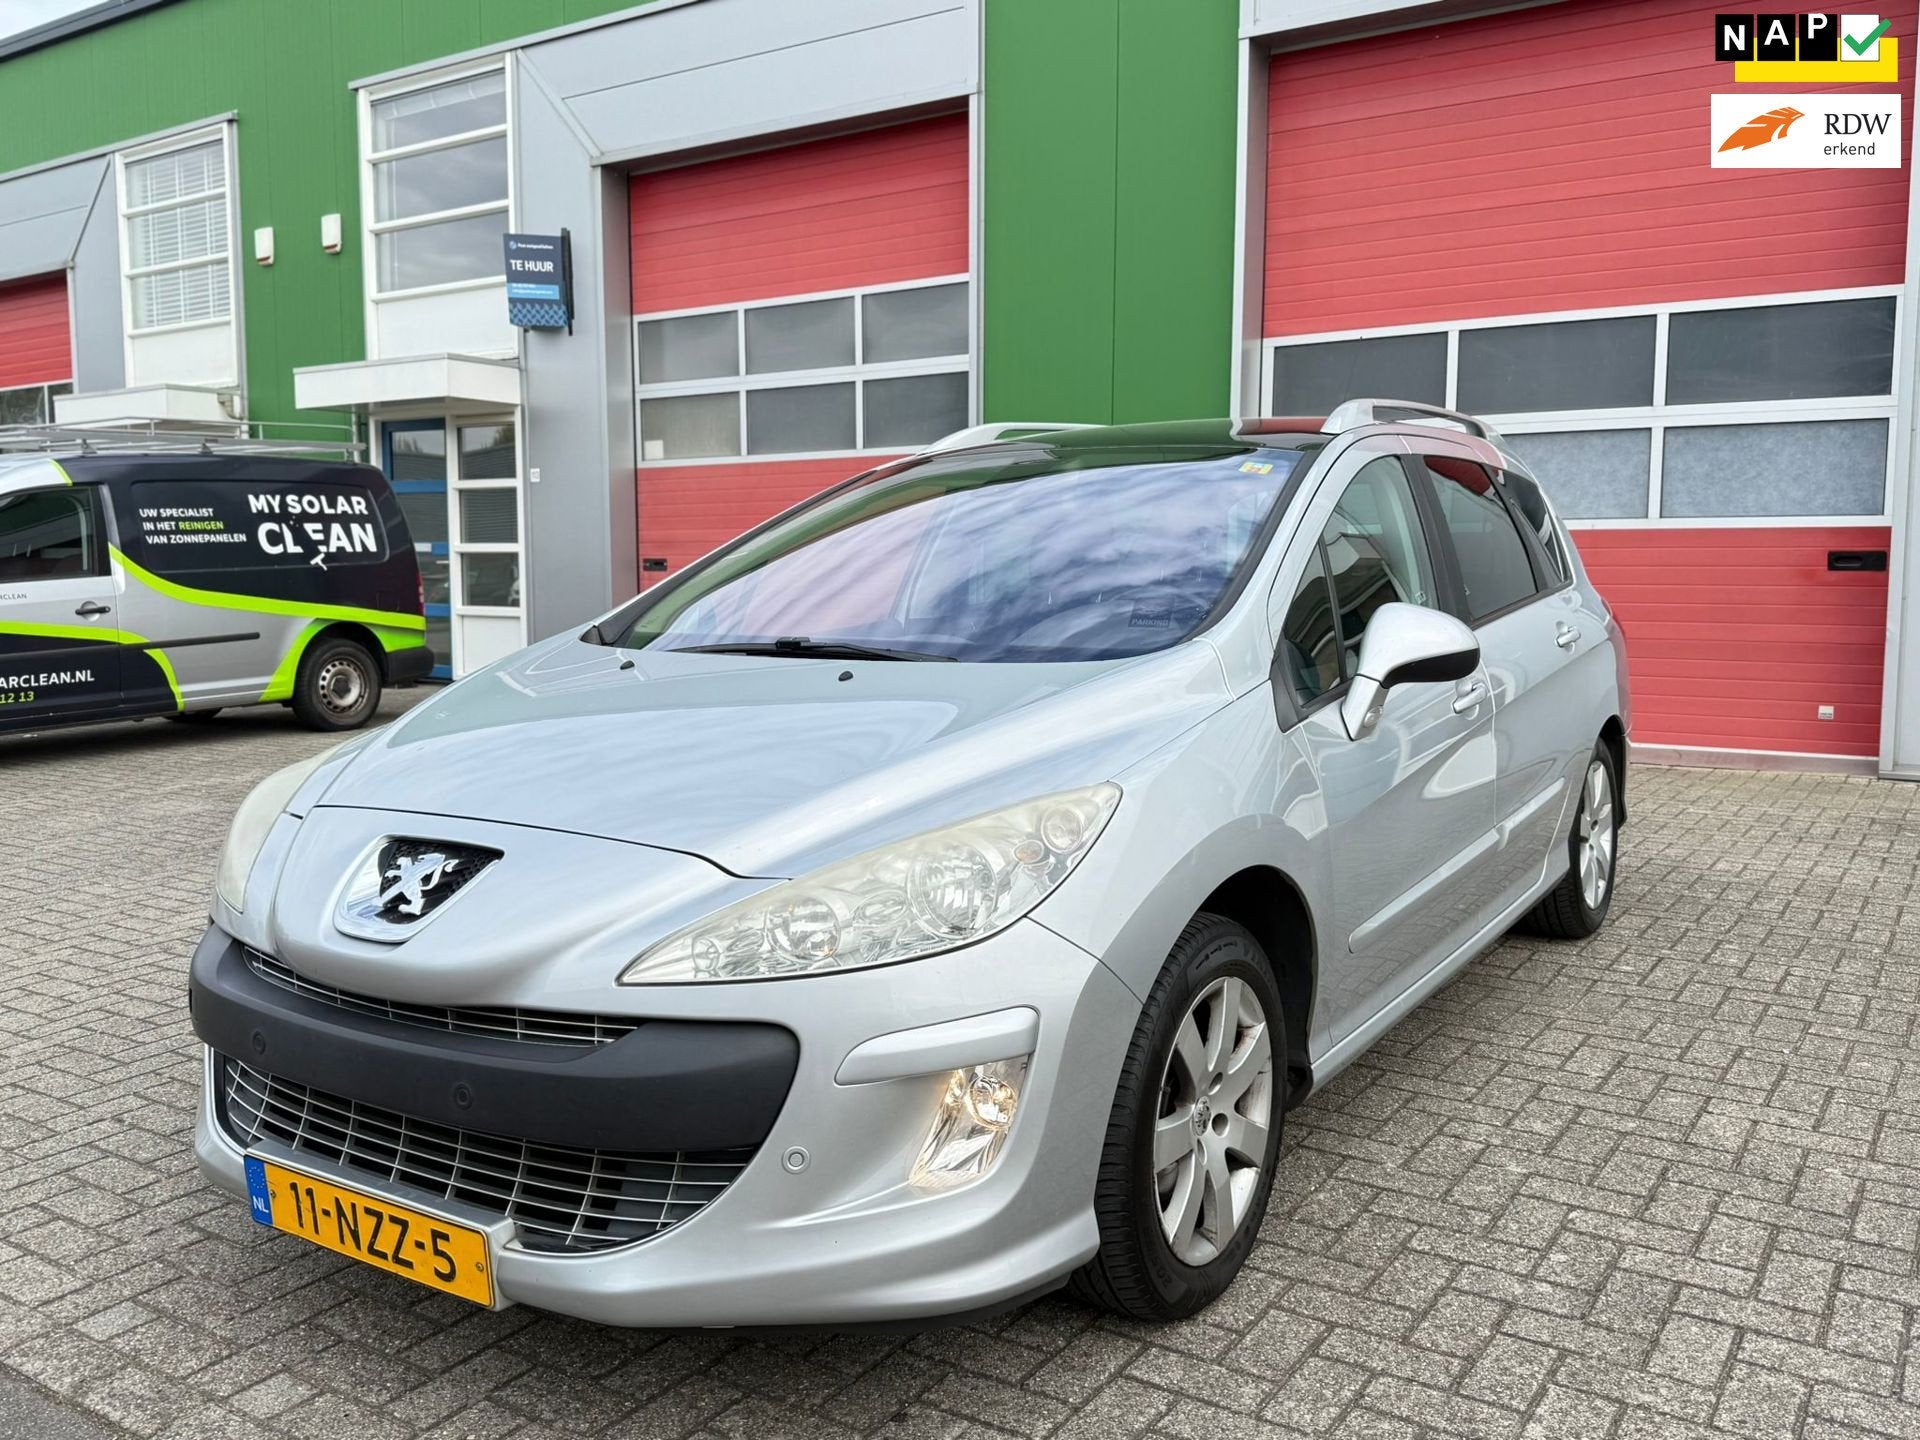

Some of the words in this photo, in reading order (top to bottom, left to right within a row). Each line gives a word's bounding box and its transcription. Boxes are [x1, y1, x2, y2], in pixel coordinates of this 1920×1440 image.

[510, 259, 523, 271] TE
[525, 260, 553, 272] HUUR
[247, 494, 280, 513] MY
[285, 494, 368, 515] SOLAR
[139, 508, 158, 518] UW
[159, 507, 214, 518] SPECIALIST
[142, 521, 155, 531] IN
[156, 521, 176, 531] HET
[178, 520, 224, 531] REINIGEN
[145, 535, 168, 545] VAN
[169, 533, 247, 544] ZONNEPANELEN
[257, 521, 378, 555] CLEAN
[0, 669, 95, 689] ARCLEAN.NL
[18, 690, 35, 702] 13
[252, 1196, 270, 1214] NL
[289, 1181, 457, 1283] 11-NZZ-5
